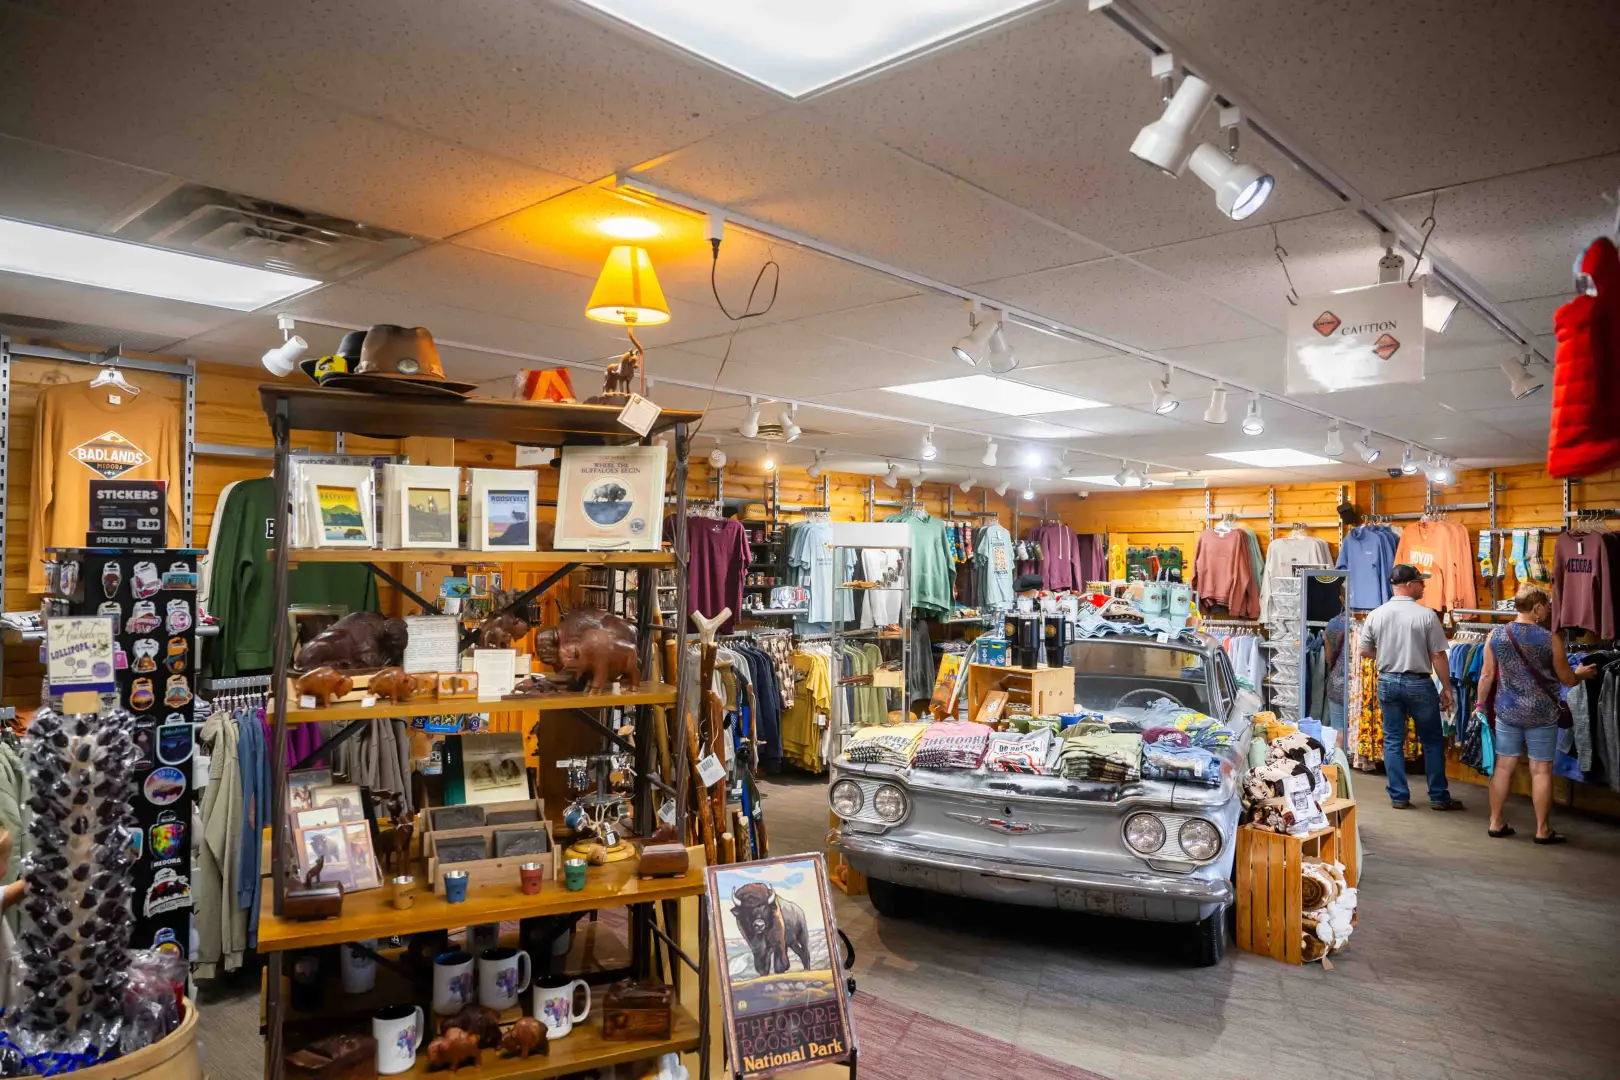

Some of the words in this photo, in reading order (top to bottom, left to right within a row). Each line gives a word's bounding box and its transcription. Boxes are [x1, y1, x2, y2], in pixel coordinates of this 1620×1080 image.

[1341, 319, 1397, 336] CAUTION
[77, 447, 144, 465] BADLANDS
[97, 489, 158, 500] STICKERS
[96, 536, 129, 544] STICKER
[1565, 557, 1592, 574] MEDORA
[153, 857, 181, 868] MEDORA
[738, 1005, 839, 1039] THEODORE
[741, 1021, 840, 1056] ROOSEVELT
[743, 1045, 807, 1073] National
[808, 1038, 843, 1059] Park
